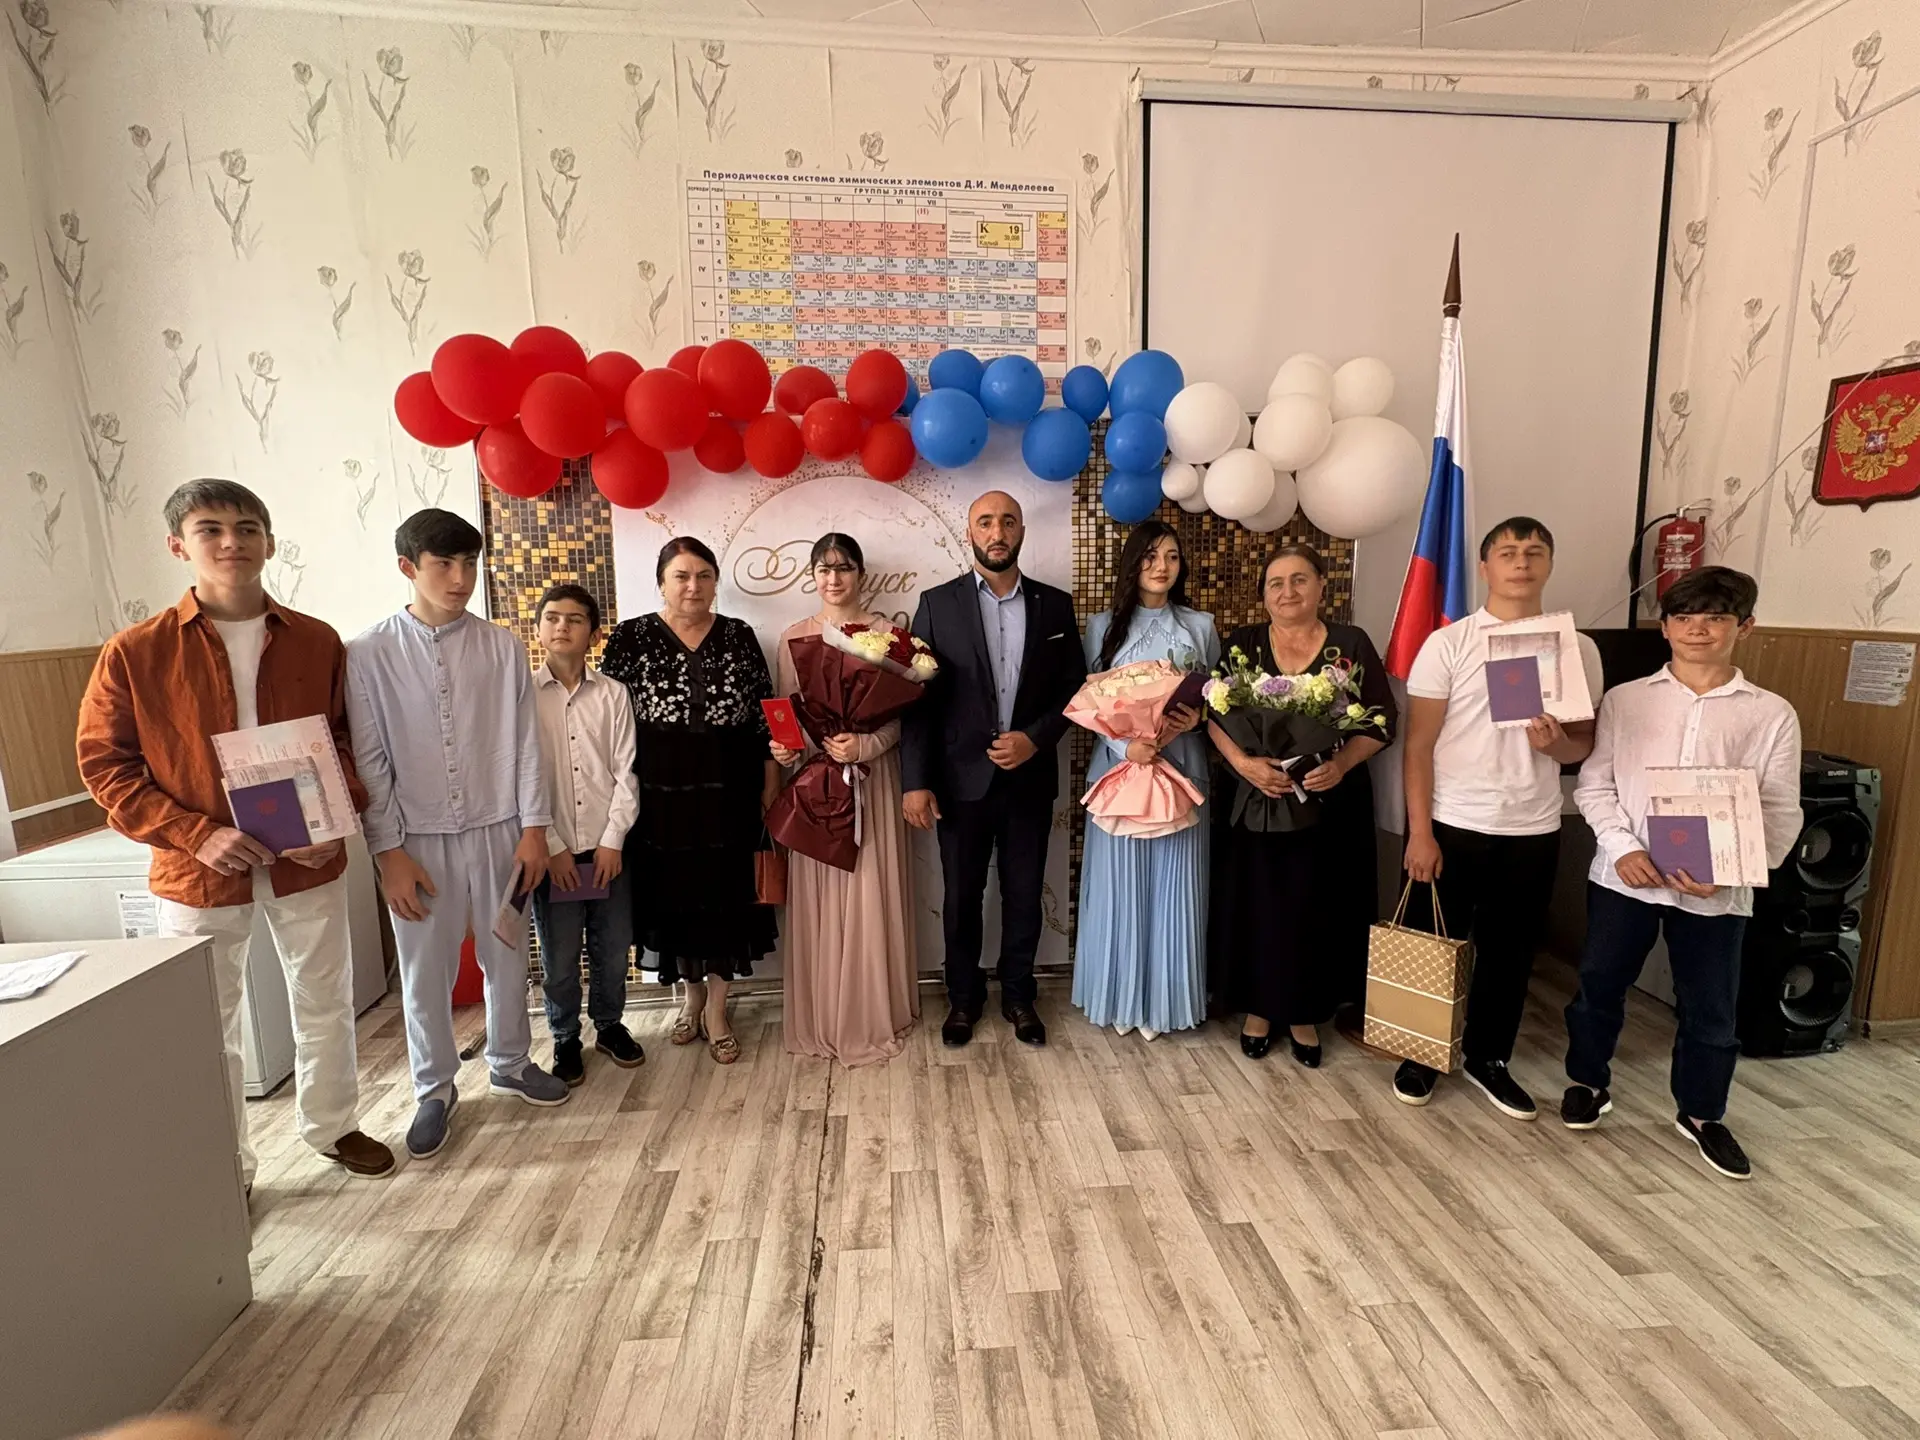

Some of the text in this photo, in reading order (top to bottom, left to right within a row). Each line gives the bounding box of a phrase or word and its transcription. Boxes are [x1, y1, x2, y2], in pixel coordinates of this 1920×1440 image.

[704, 170, 1055, 192] Периодическая система химических элементов Д.И. Менделеева
